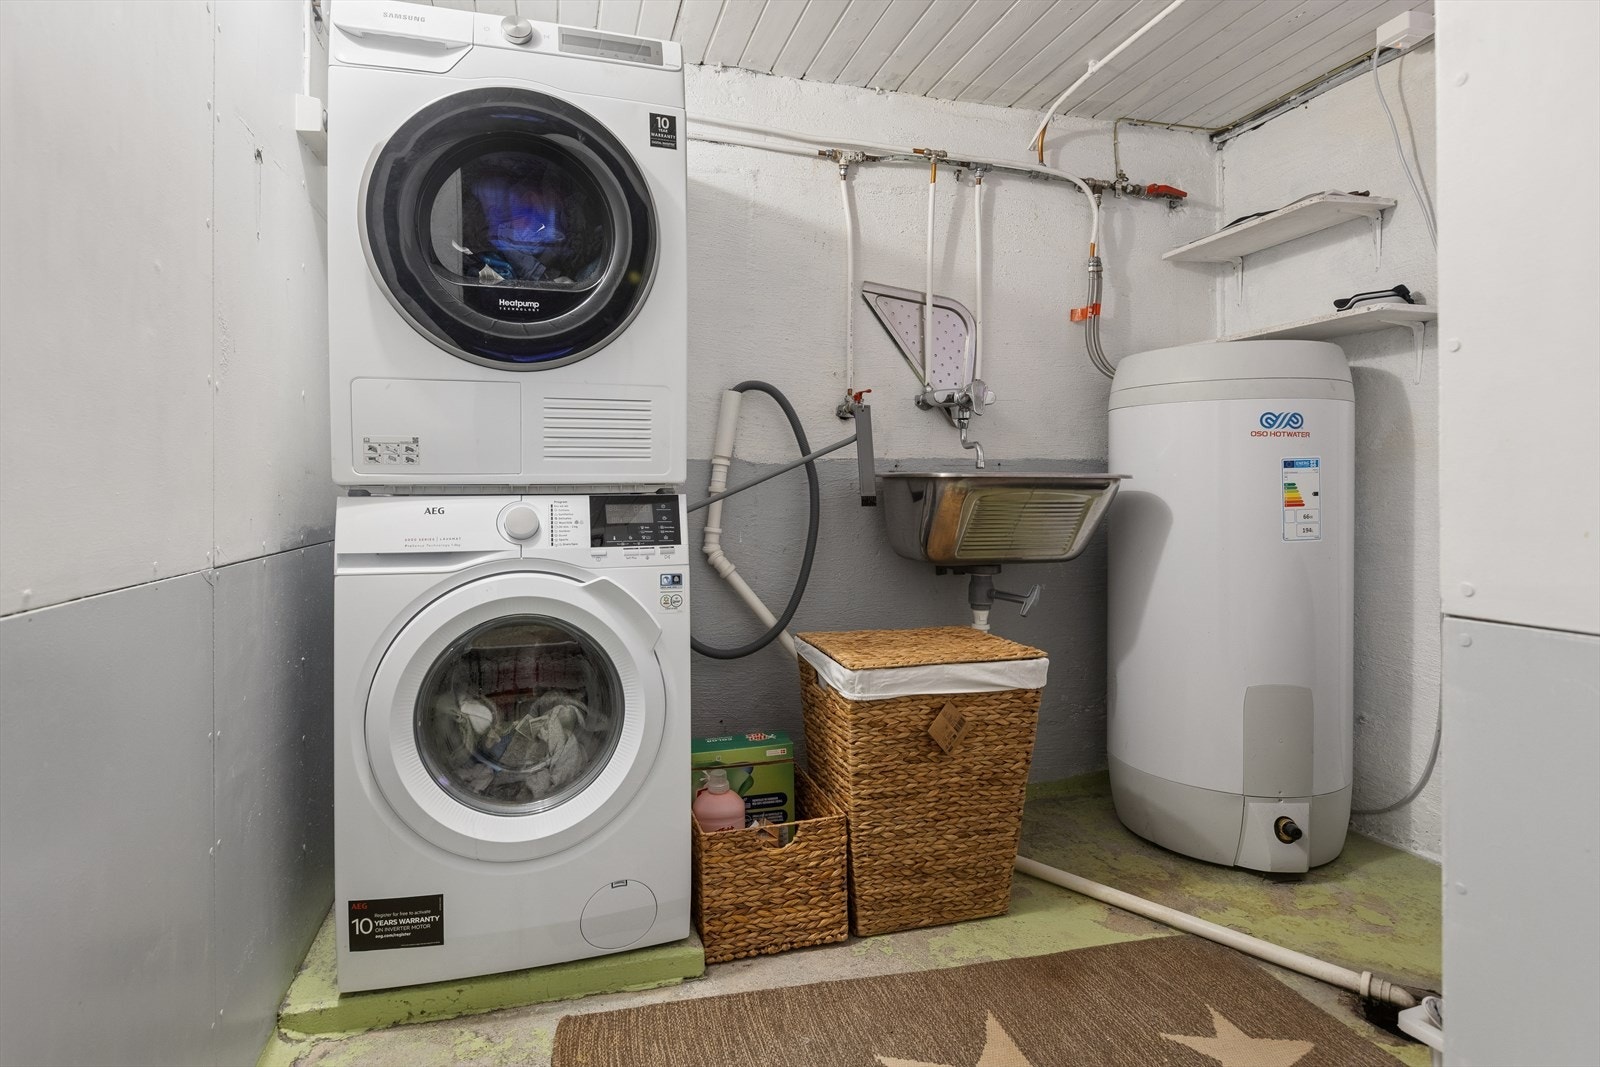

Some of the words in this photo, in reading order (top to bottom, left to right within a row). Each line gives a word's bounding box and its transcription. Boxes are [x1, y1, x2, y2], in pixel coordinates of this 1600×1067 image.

[383, 12, 425, 22] SAMSUNG
[656, 117, 669, 129] 10
[499, 299, 539, 308] Heatpump
[399, 916, 440, 924] WARRANTY
[352, 918, 373, 934] 10
